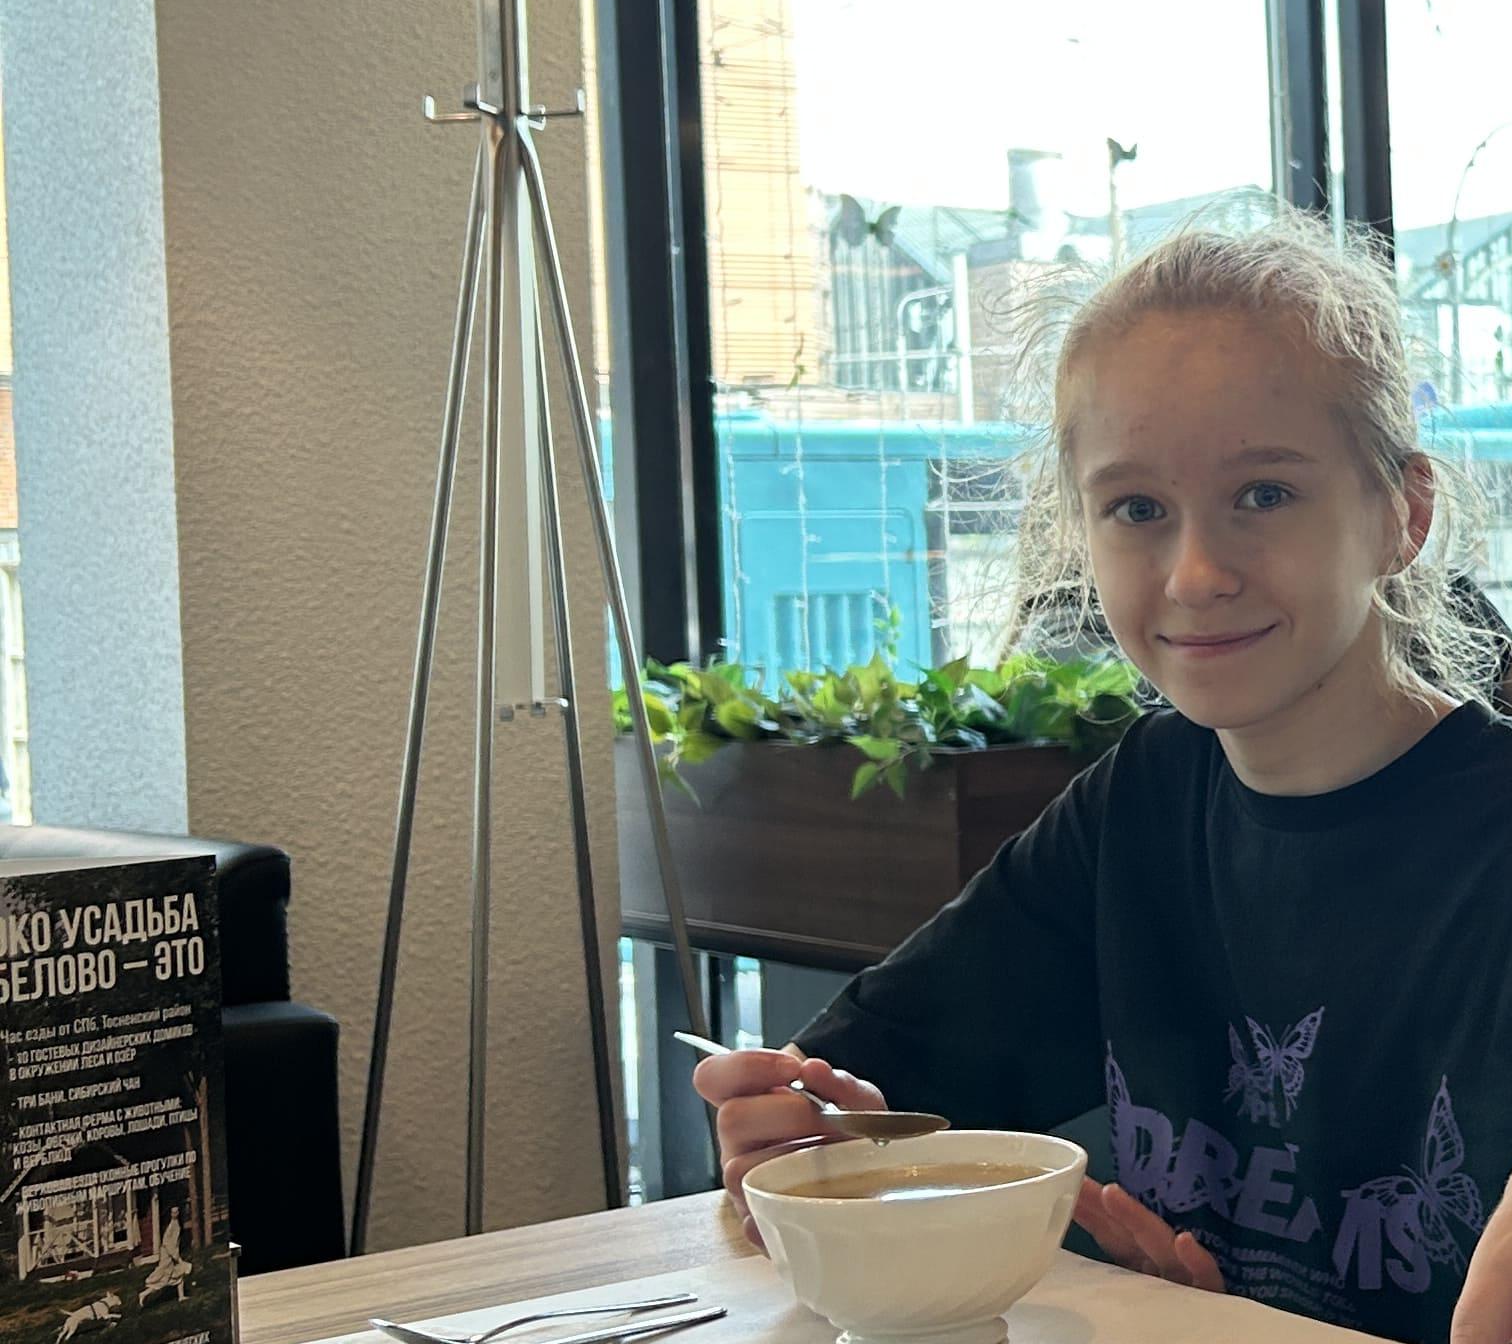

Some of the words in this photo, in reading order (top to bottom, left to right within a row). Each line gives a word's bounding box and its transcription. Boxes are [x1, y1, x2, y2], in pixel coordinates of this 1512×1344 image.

[61, 893, 199, 949] УСАДЬБА
[155, 936, 205, 981] ЭТО
[0, 1029, 23, 1044] Час
[25, 1026, 56, 1041] езды
[59, 1024, 70, 1036] от
[102, 1008, 160, 1029] Тосненский
[30, 1043, 80, 1062] ГОСТЕВЫХ
[82, 1031, 151, 1055] ДИЗАЙНЕРСКИХ
[9, 1068, 17, 1081] В
[18, 1057, 79, 1080] ОКРУЖЕНИИ
[81, 1053, 105, 1070] ЛЕСА
[17, 1095, 36, 1110] ТРИ
[68, 1078, 122, 1101] СИБИРСКИЙ
[123, 1076, 141, 1091] ЧАН
[19, 1116, 80, 1139] КОНТАКТНАЯ
[82, 1110, 115, 1131] ФЕРМА
[116, 1108, 123, 1121] С
[140, 1152, 184, 1174] ПРОГУЛКИ
[185, 1150, 196, 1164] ПО
